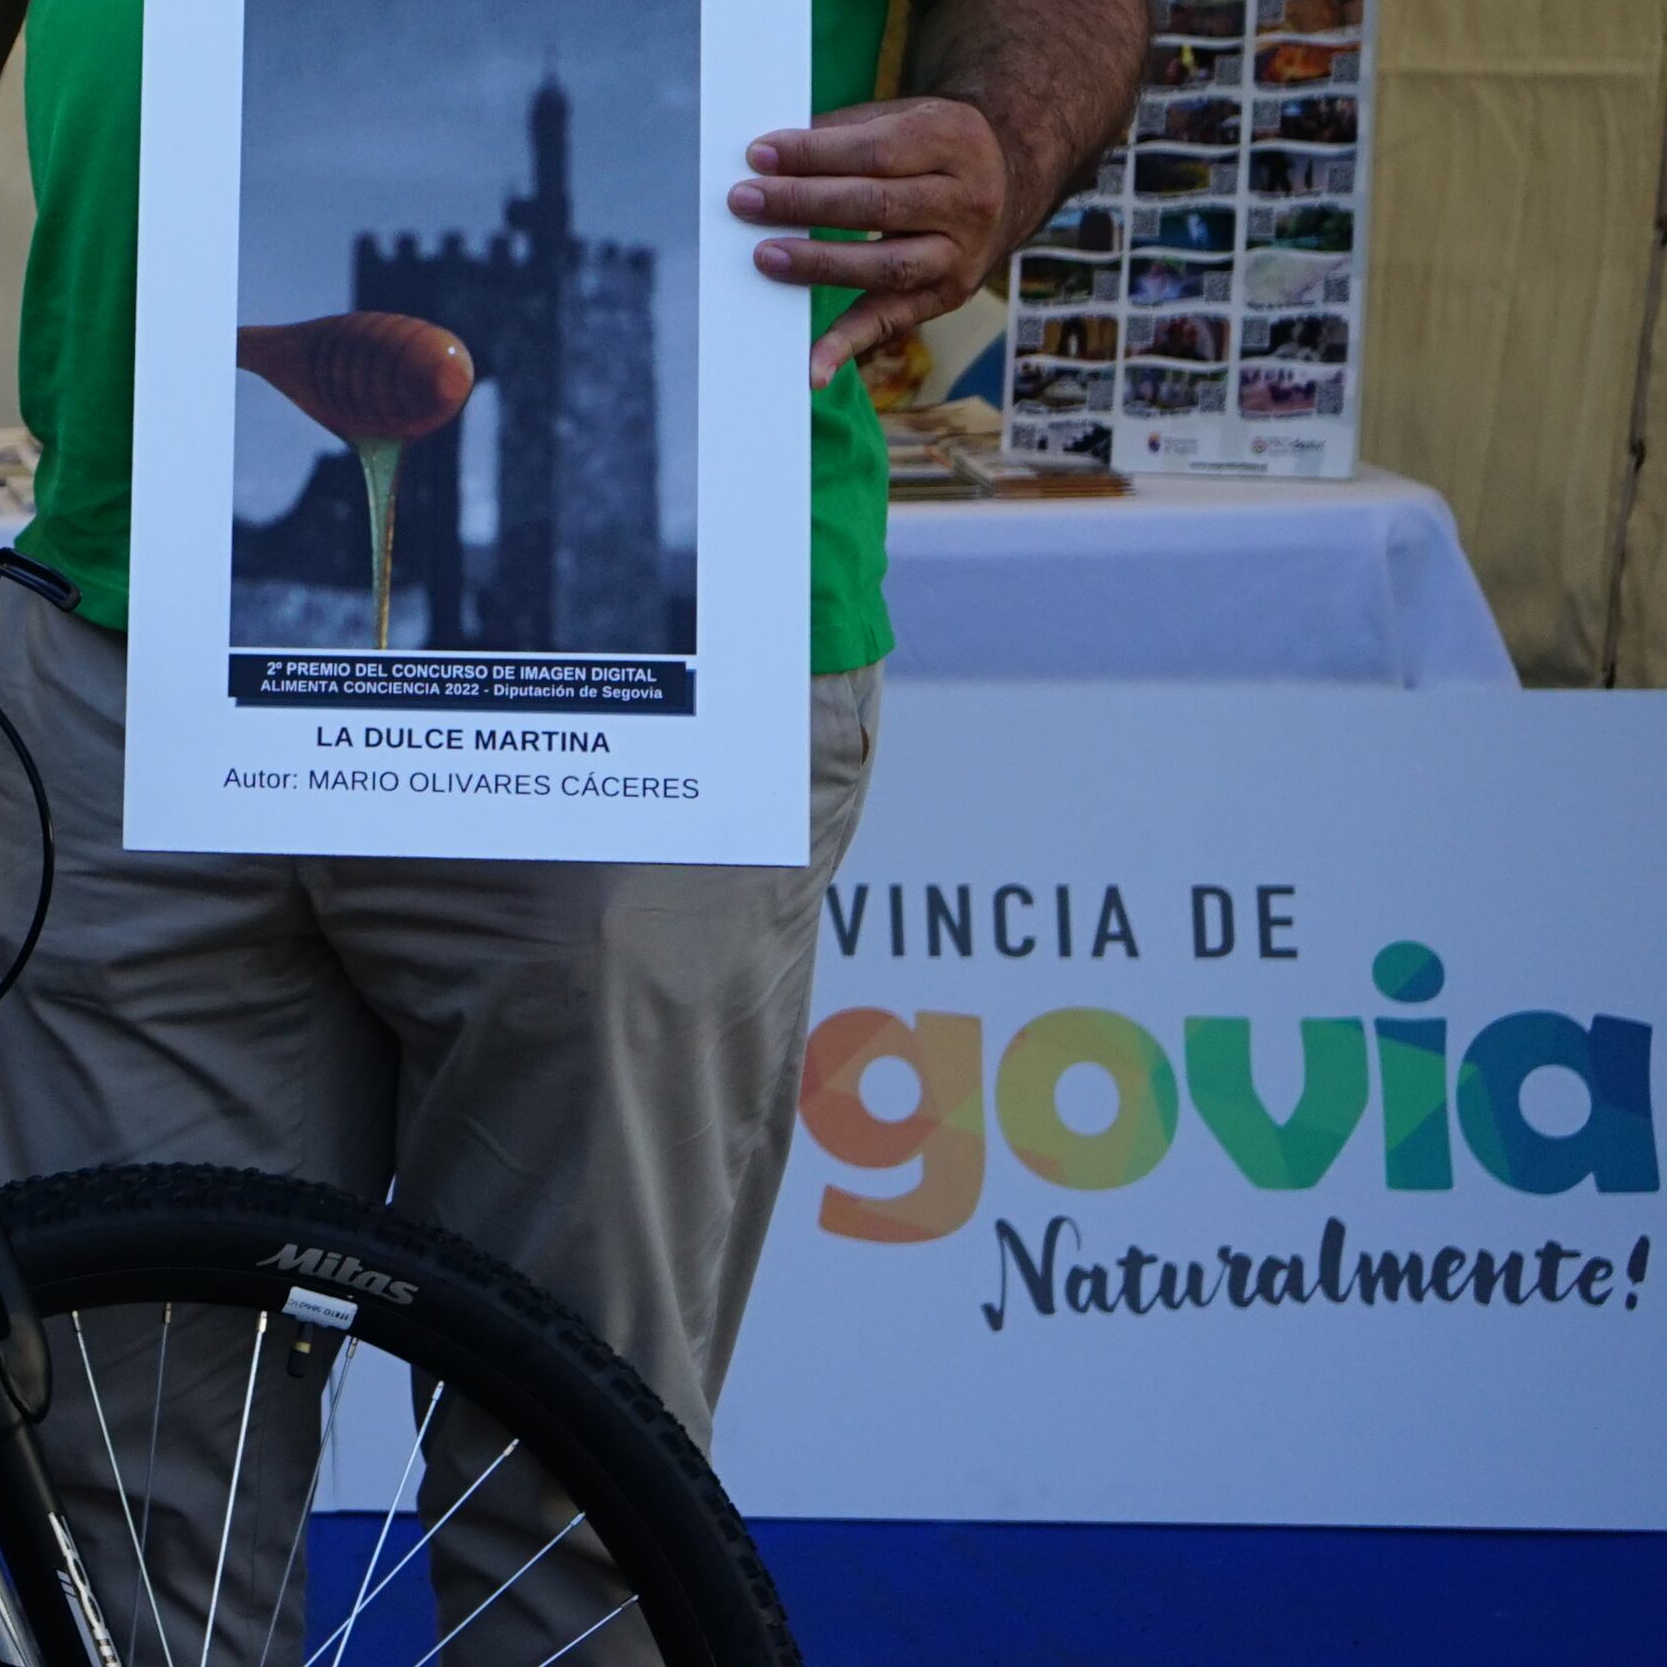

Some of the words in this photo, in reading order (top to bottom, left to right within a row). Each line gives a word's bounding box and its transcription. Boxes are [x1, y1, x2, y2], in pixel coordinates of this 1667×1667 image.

[286, 662, 351, 677] PREMIO
[355, 663, 387, 678] DEL
[392, 664, 488, 680] CONCURSO
[492, 666, 515, 680] DE
[520, 667, 586, 682] IMAGEN
[591, 668, 657, 683] DIGITAL
[261, 679, 338, 693] ALIMENTA
[343, 681, 440, 695] CONCIENCIA
[445, 683, 479, 696] 2022
[494, 684, 574, 700] Diputación
[579, 685, 597, 698] de
[602, 686, 663, 702] Segovia
[317, 726, 353, 748] LA
[365, 727, 464, 750] DULCE
[474, 729, 611, 753] MARTINA
[223, 767, 298, 790] Autor:
[308, 770, 399, 792] MARIO
[409, 771, 551, 796] OLIVARES
[561, 771, 700, 800] CÁCERES
[1191, 883, 1301, 961] DE
[256, 1243, 419, 1305] Mitas
[981, 1215, 1651, 1331] Naturalmente!
